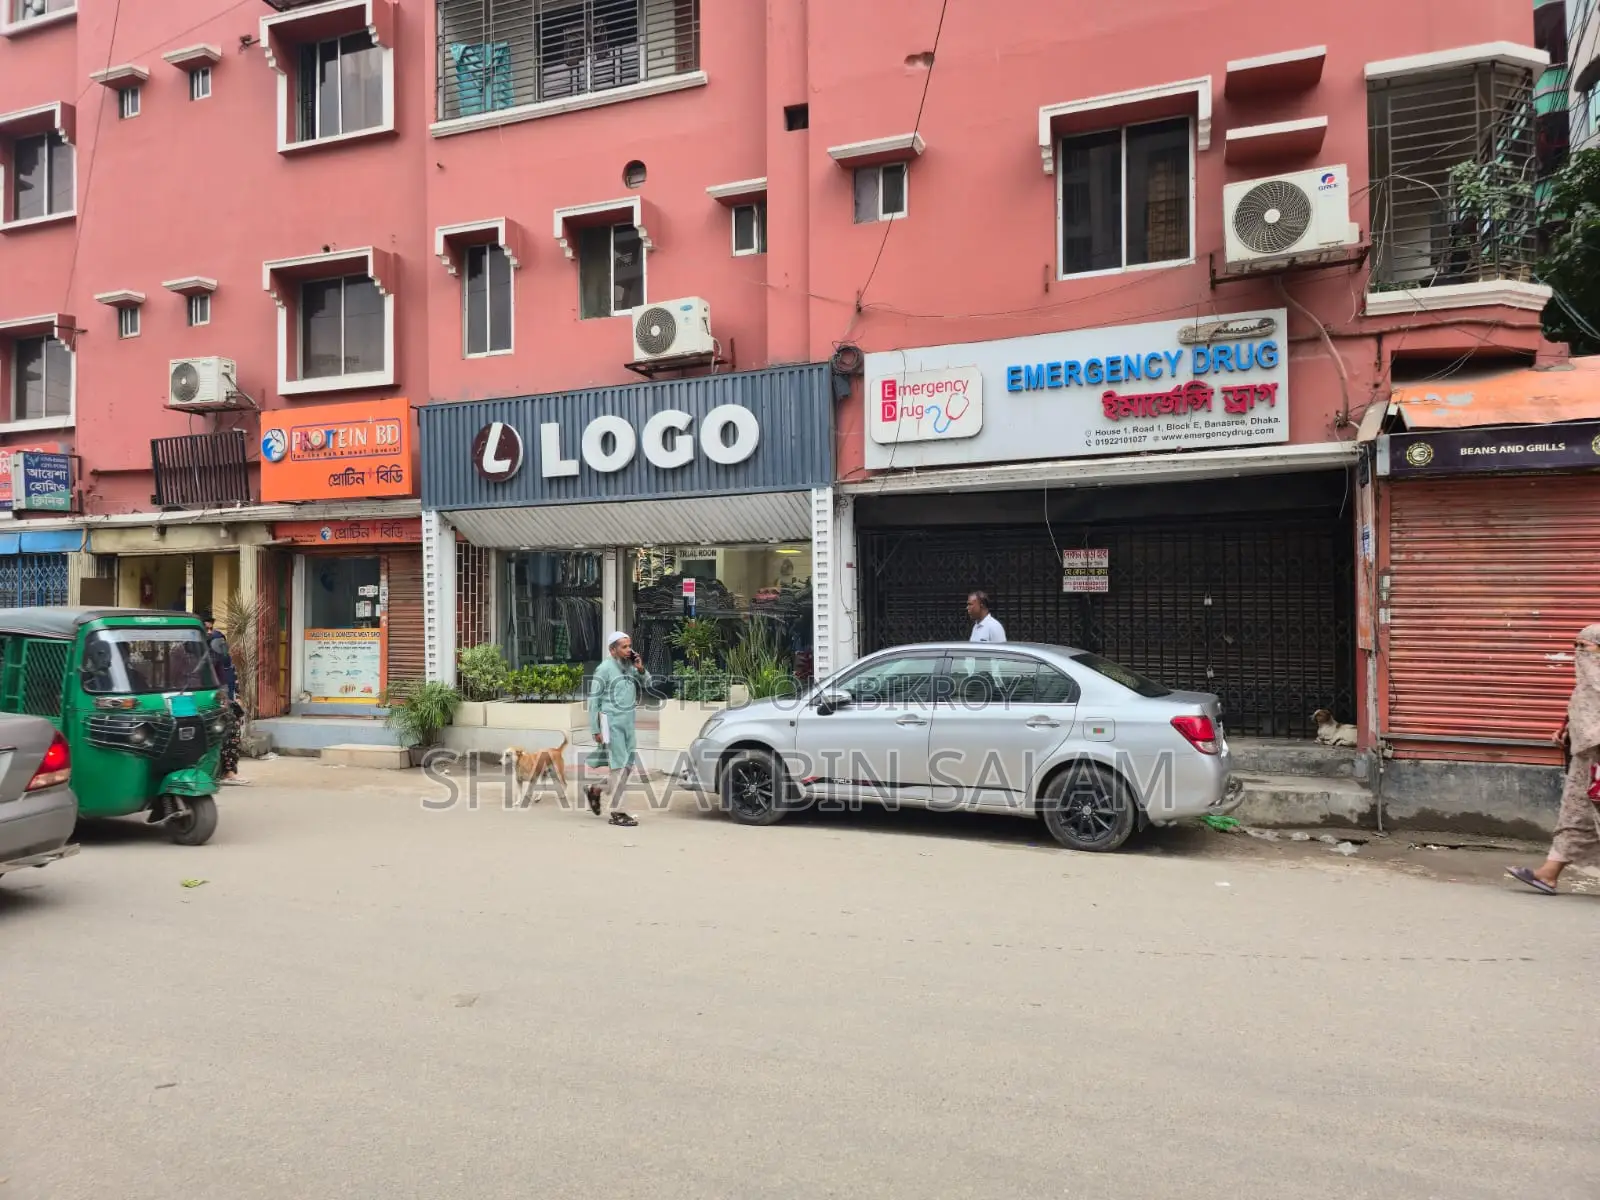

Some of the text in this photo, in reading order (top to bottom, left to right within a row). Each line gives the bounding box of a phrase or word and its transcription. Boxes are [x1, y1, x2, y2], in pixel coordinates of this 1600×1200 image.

[1318, 183, 1339, 191] GREE
[1007, 340, 1279, 392] EMERGENCY DRUG
[881, 379, 970, 401] Emergency
[1101, 380, 1279, 421] ইমার্জেন্সি ড্রাগ
[881, 401, 924, 422] Drug
[1095, 428, 1121, 436] House
[1132, 424, 1155, 433] Road
[1166, 420, 1190, 431] Block
[1193, 420, 1202, 429] E,
[1204, 418, 1248, 430] Banasree,
[1250, 415, 1281, 425] Dhaka.
[291, 423, 400, 452] PROTEIN BD
[540, 403, 760, 478] LOGO
[1095, 429, 1274, 446] 01922101027 www.emergencydrug.com
[1460, 442, 1566, 456] BEANS AND GRILLS
[26, 468, 68, 481] আয়েশা
[328, 463, 403, 487] প্রোটিন বিডি
[29, 480, 66, 493] হোমিও
[334, 523, 370, 540] প্রোটিন
[380, 523, 403, 538] বিডি
[679, 549, 717, 558] TRIAL ROOM
